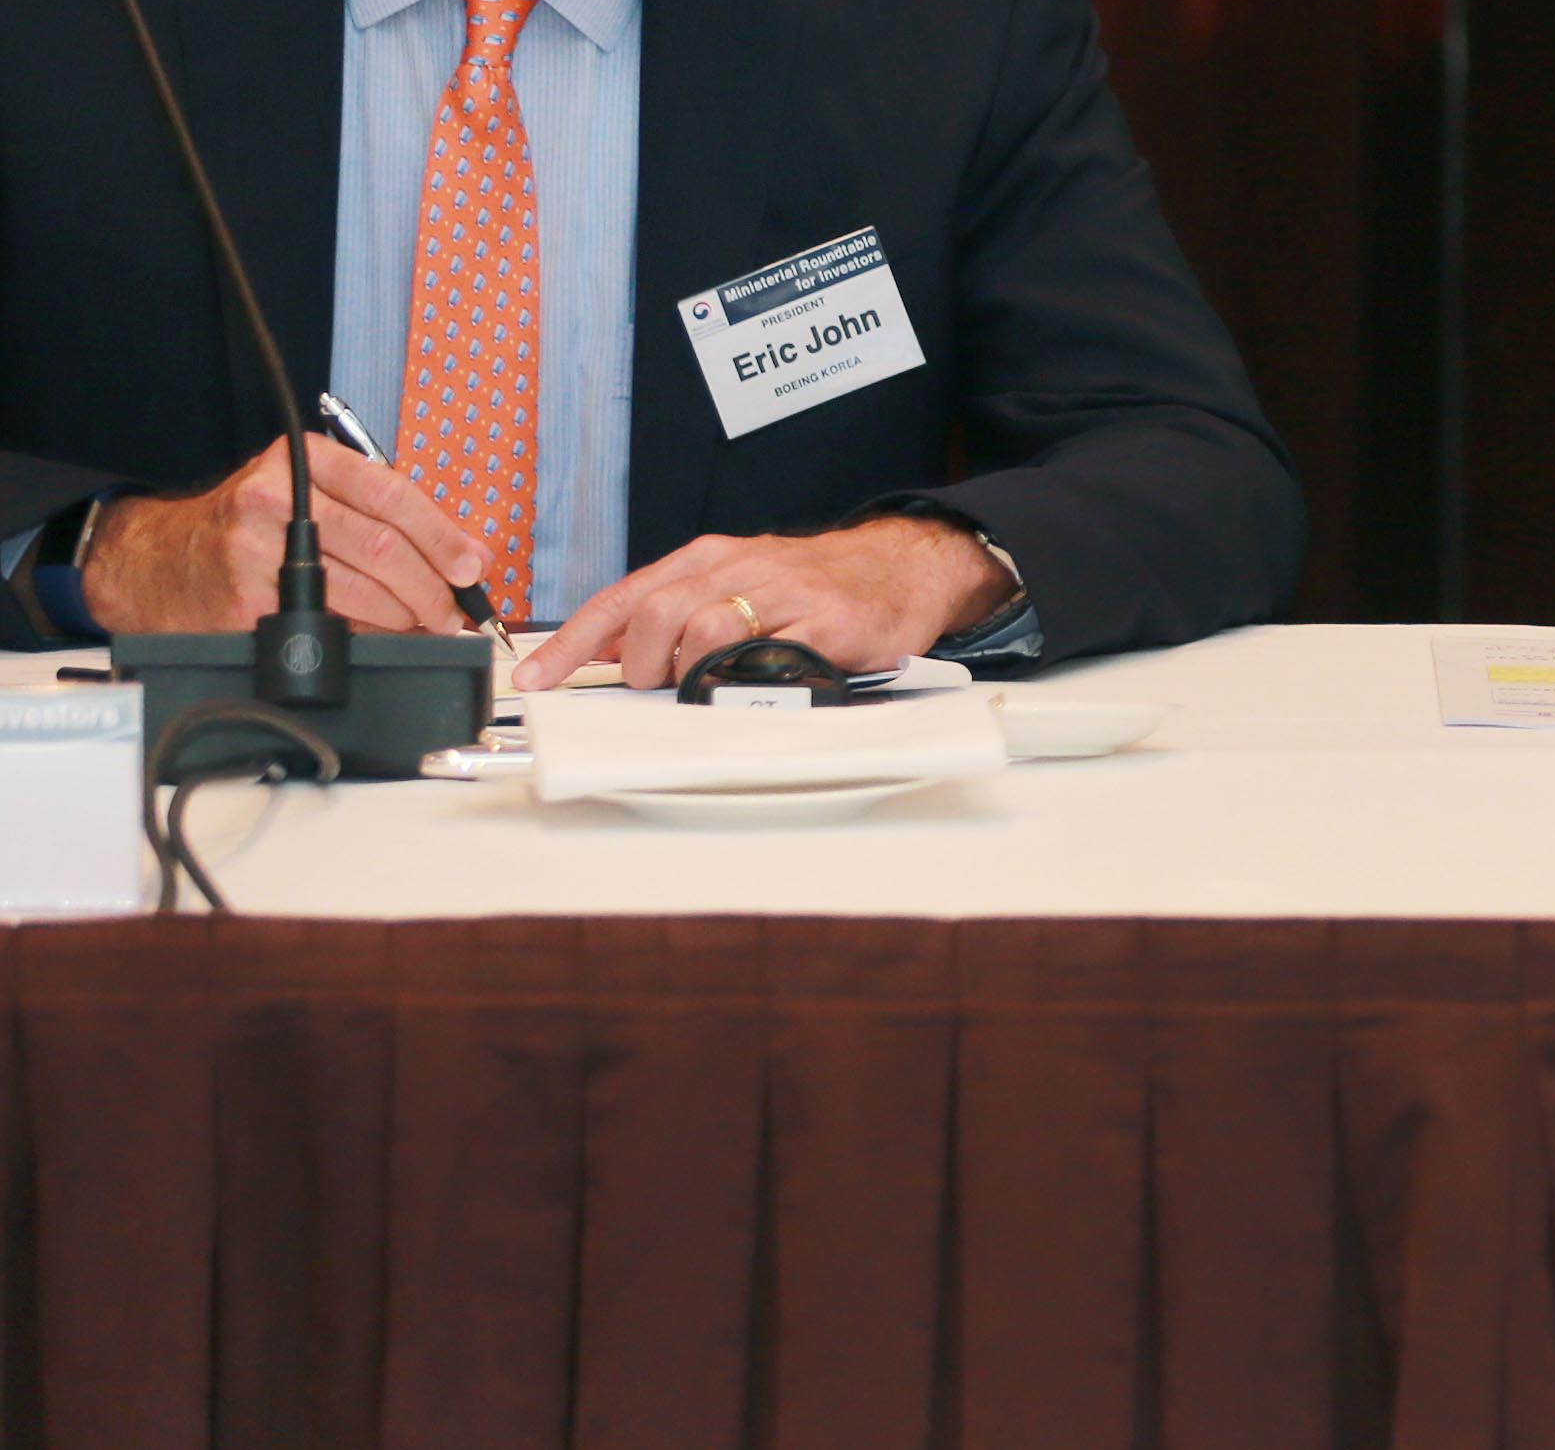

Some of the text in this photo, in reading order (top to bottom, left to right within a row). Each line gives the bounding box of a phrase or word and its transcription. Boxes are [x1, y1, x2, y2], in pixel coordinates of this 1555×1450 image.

[723, 234, 877, 304] Ministerial Roundtable
[795, 249, 883, 293] for Investors
[760, 296, 826, 328] PRESIDENT
[731, 308, 883, 383] Eric John
[773, 372, 820, 397] BOEING
